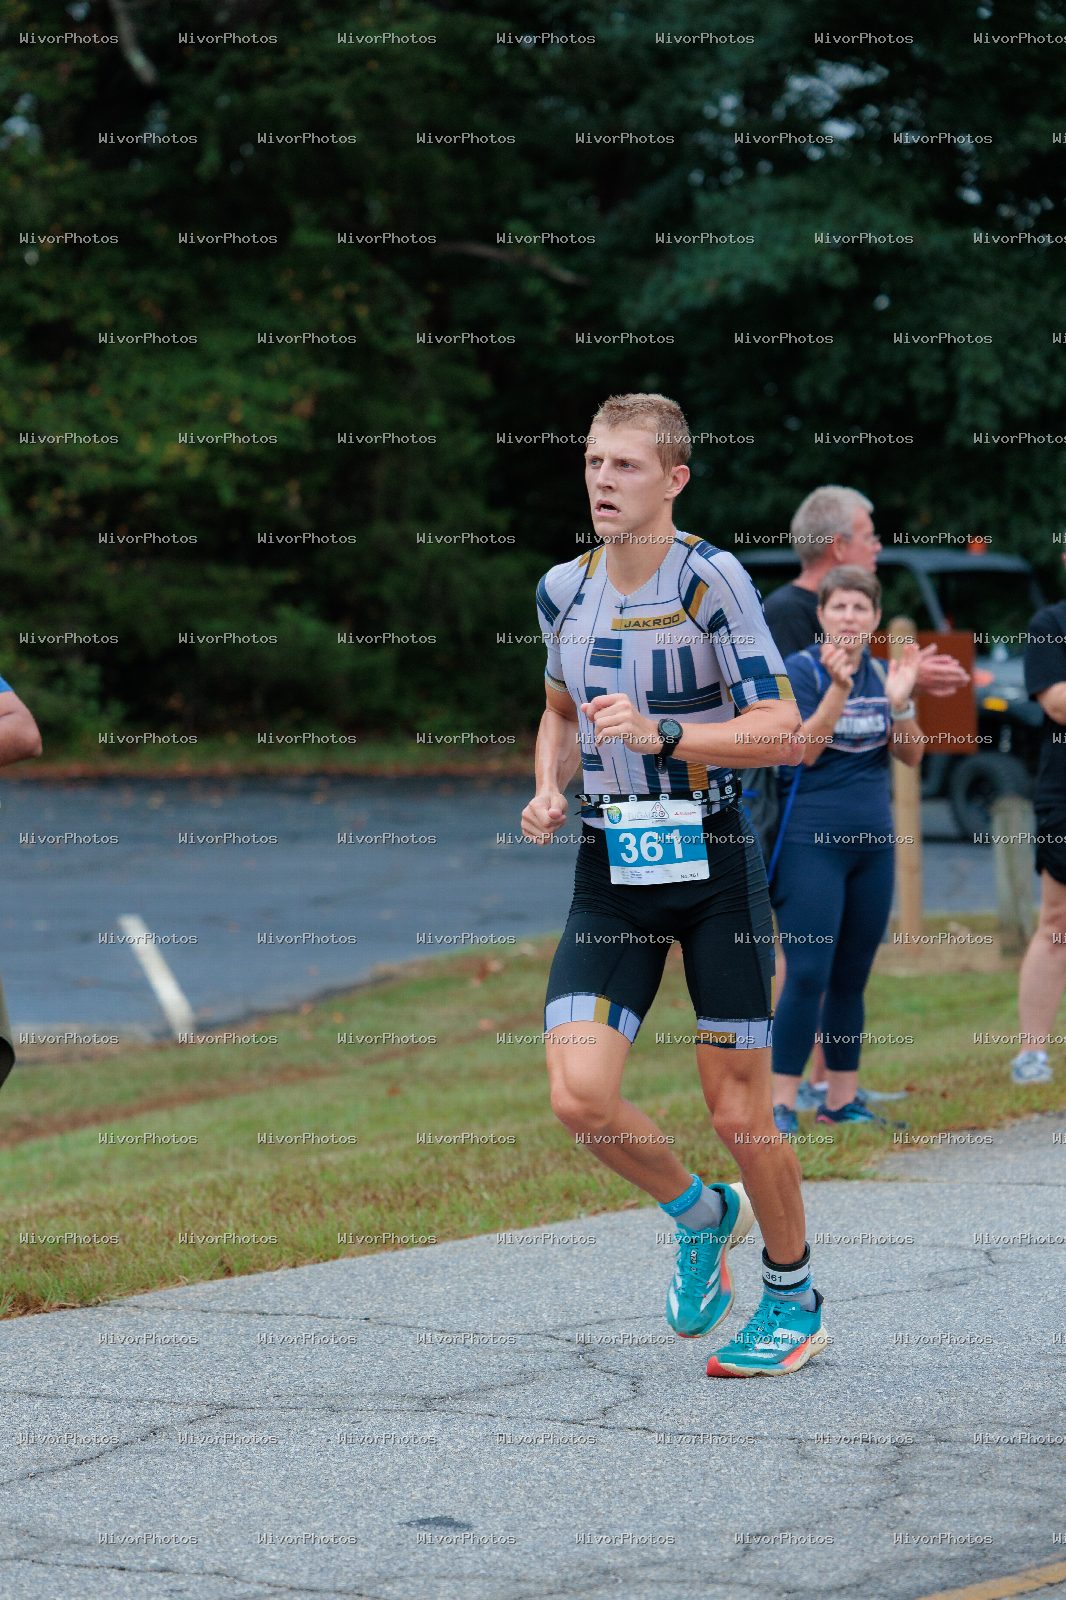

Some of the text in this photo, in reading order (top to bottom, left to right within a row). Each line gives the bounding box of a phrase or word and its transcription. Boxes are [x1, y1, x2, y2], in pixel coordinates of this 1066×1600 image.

[624, 613, 680, 628] JAKROO
[618, 829, 684, 864] 361
[765, 1271, 782, 1282] 361
